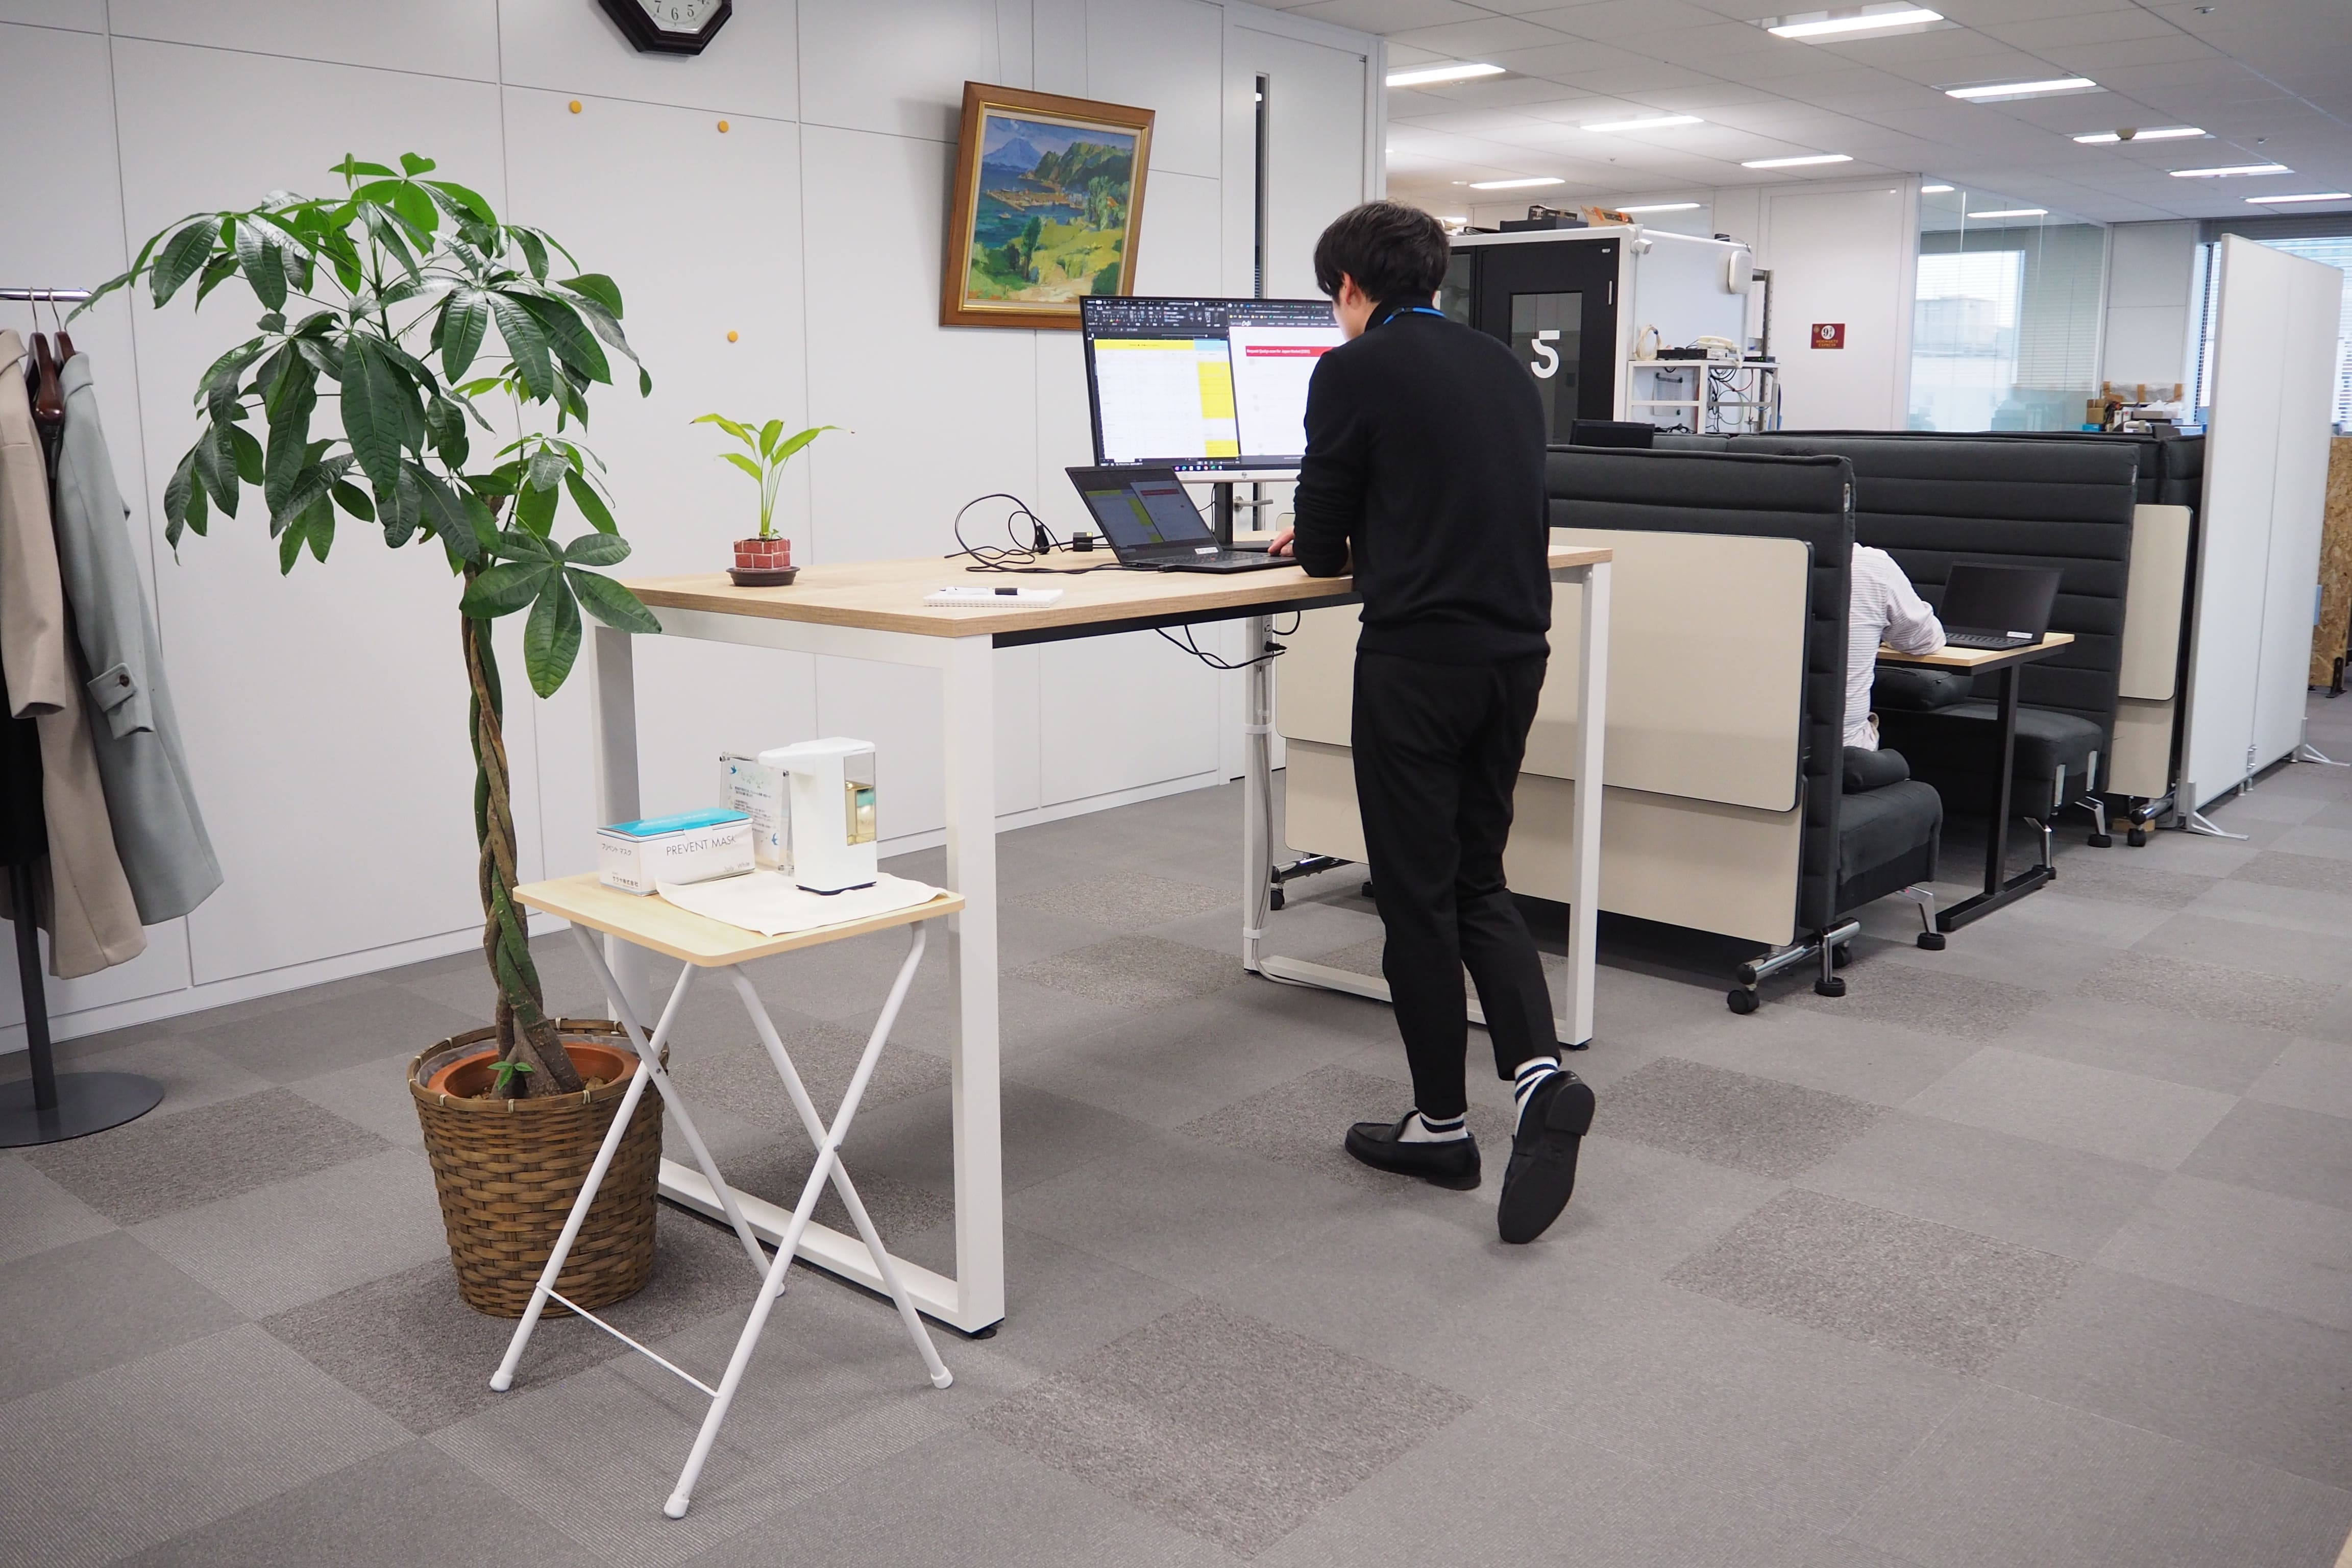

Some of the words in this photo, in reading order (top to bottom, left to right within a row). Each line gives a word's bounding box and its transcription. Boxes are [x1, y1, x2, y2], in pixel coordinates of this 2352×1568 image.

[654, 0, 662, 13] 7
[687, 5, 694, 17] 5
[671, 7, 679, 21] 6
[1531, 330, 1560, 379] 5
[666, 840, 708, 856] PREVENT
[712, 834, 737, 848] MASK
[619, 848, 632, 856] マスク
